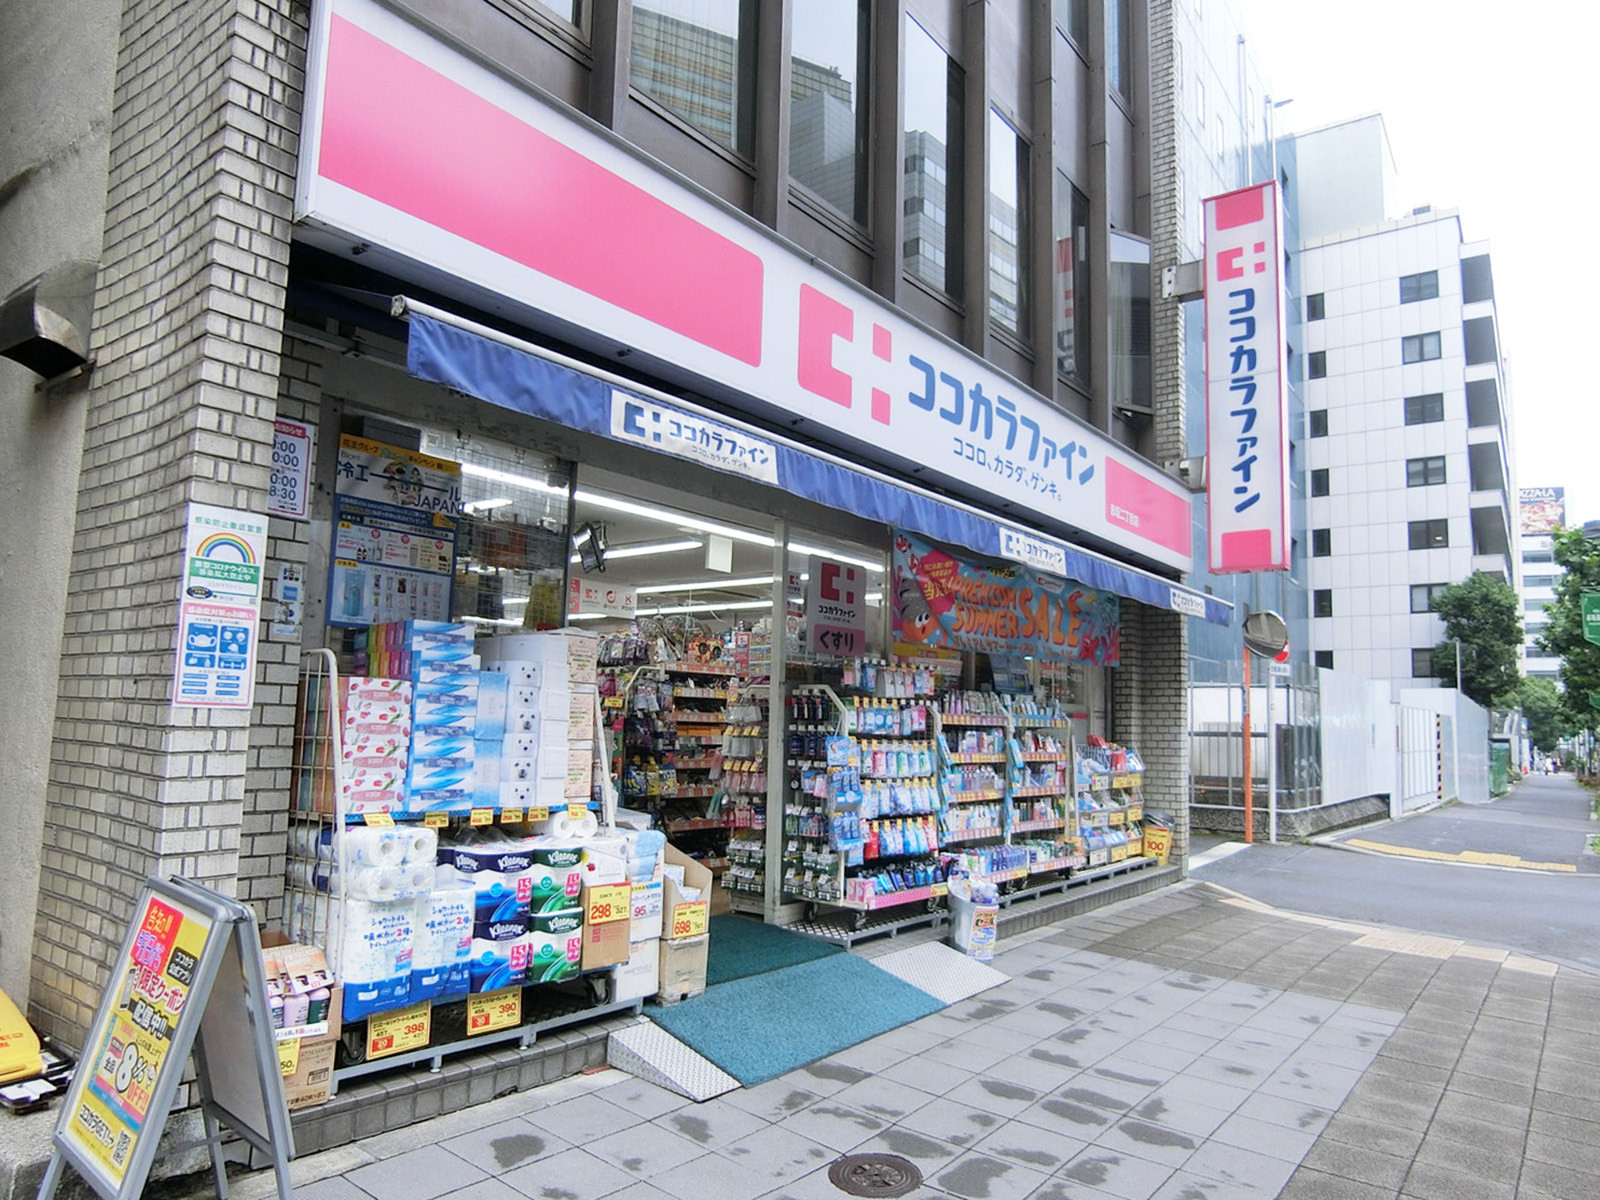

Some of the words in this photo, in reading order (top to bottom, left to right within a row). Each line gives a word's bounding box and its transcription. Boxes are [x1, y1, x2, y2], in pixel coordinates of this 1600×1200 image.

[1228, 287, 1260, 514] ココカラファイン
[908, 354, 1095, 486] ココカラファイン
[669, 419, 769, 465] ココカラファイン
[953, 437, 1062, 501] ココロ、カラダ、ゲンキ。
[818, 605, 856, 618] ココカラファイン
[1018, 587, 1082, 648] SALE
[952, 602, 1019, 638] SUMMER
[820, 630, 854, 653] くすり
[456, 854, 479, 870] Kleenex
[498, 855, 531, 870] Kleenex
[548, 850, 579, 865] Kleenex
[591, 903, 611, 919] 298
[489, 922, 525, 938] Kleenex
[548, 917, 579, 931] Kleenex
[675, 920, 691, 934] 698
[499, 1002, 516, 1014] 390
[404, 1022, 425, 1035] 398
